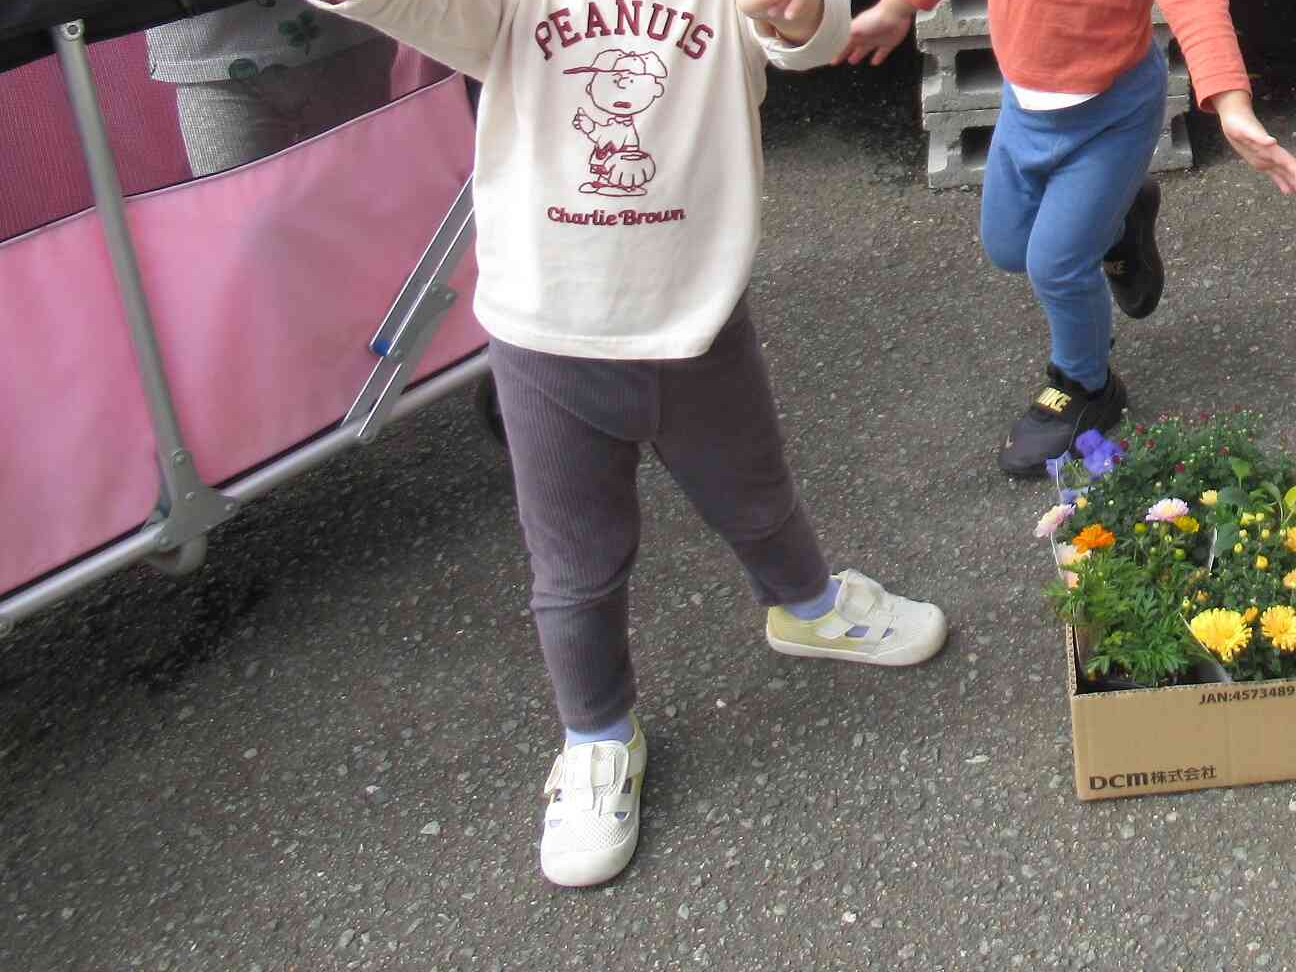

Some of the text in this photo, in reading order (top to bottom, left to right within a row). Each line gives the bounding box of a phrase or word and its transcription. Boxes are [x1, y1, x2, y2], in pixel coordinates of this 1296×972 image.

[535, 0, 714, 61] PEANUTS
[547, 206, 686, 226] Charlie Brown
